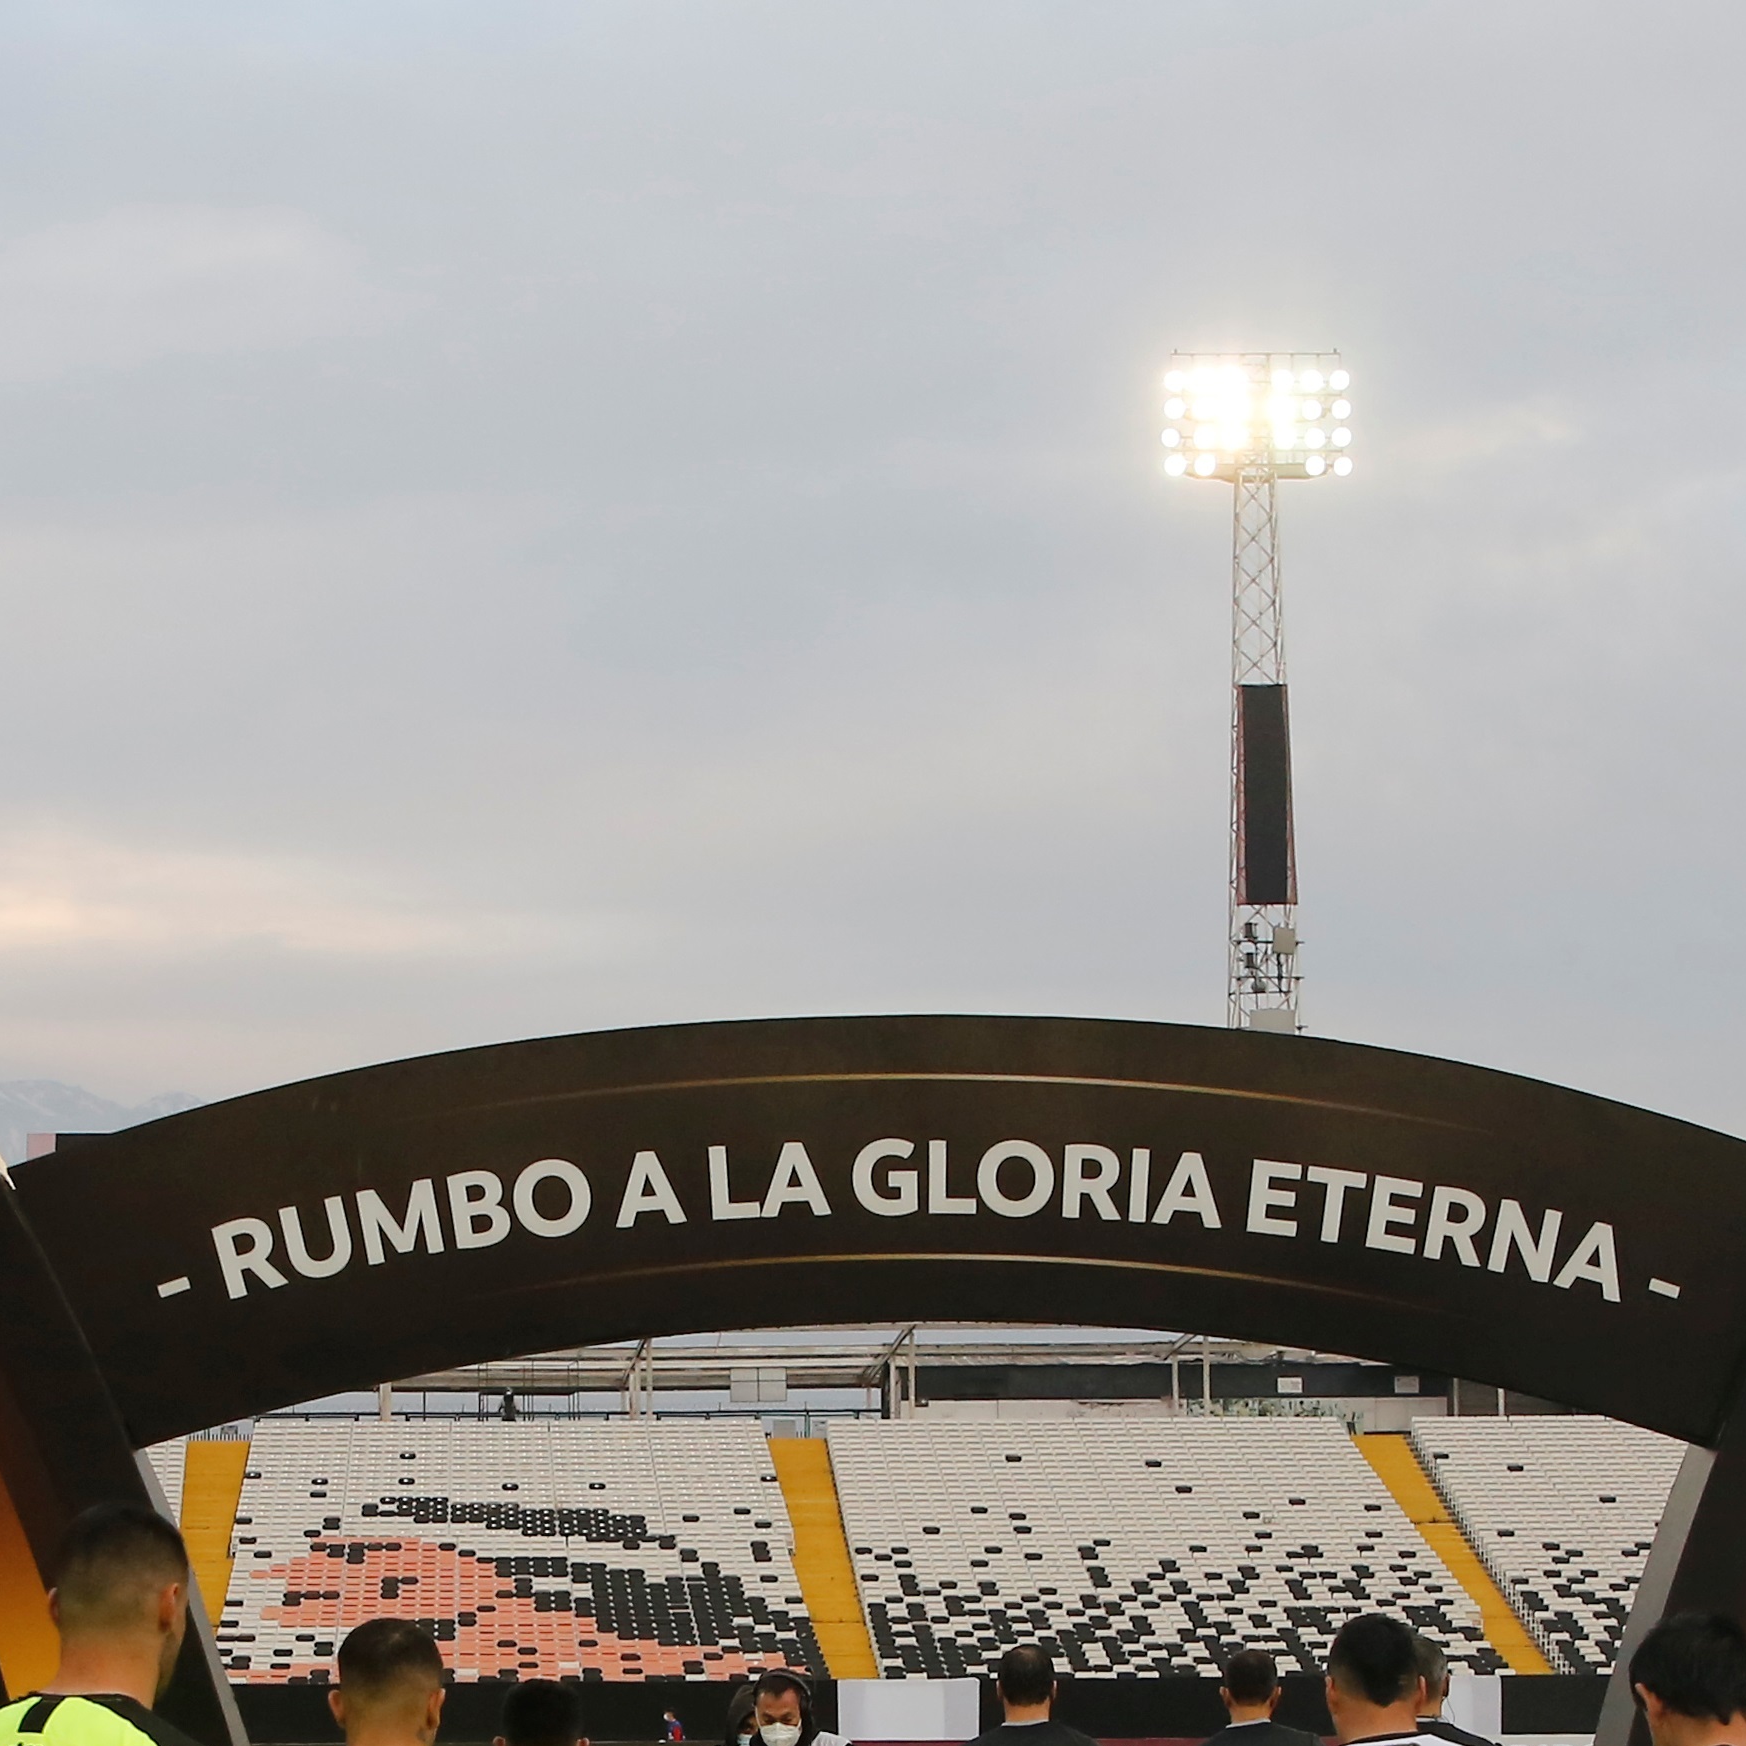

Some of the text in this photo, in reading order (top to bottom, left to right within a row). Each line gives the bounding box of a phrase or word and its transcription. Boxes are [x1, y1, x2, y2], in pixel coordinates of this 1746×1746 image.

[210, 1158, 592, 1299] RUMBO
[615, 1150, 687, 1228] A
[707, 1141, 831, 1221] LA
[851, 1138, 1221, 1229] GLORIA
[1245, 1158, 1620, 1303] ETERNA
